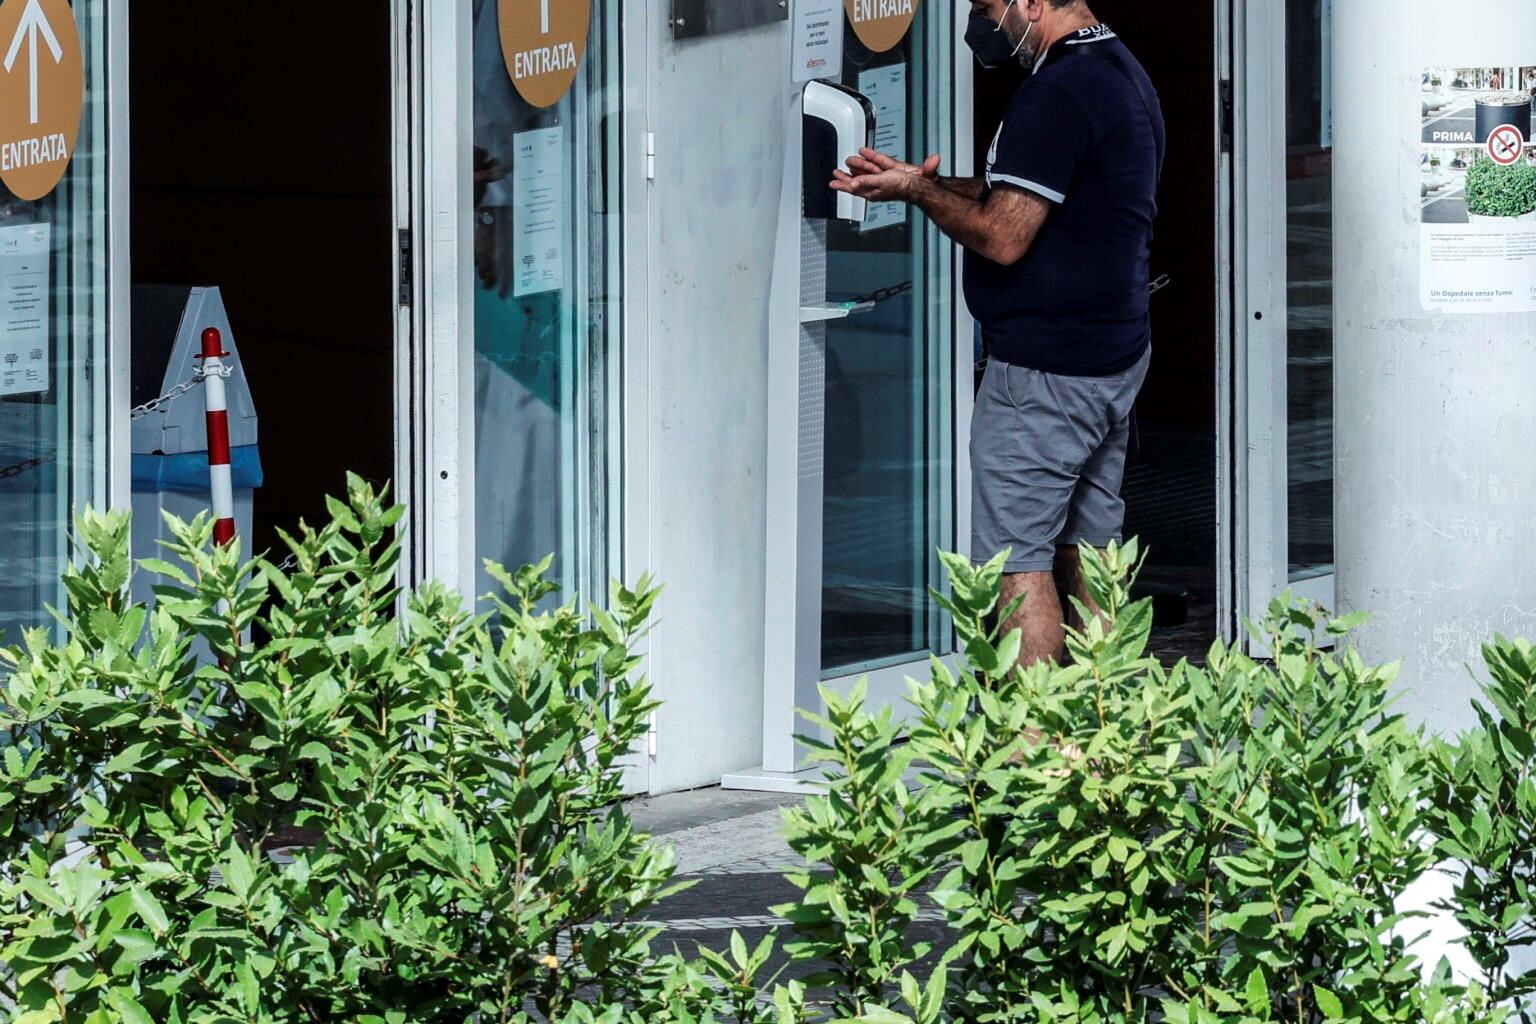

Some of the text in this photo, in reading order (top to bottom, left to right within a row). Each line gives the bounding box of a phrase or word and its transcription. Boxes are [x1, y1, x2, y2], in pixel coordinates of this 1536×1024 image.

[514, 41, 577, 79] ENTRATA
[1432, 131, 1474, 142] PRIMA
[1, 132, 68, 171] ENTRATA
[1441, 290, 1474, 298] Ospedale
